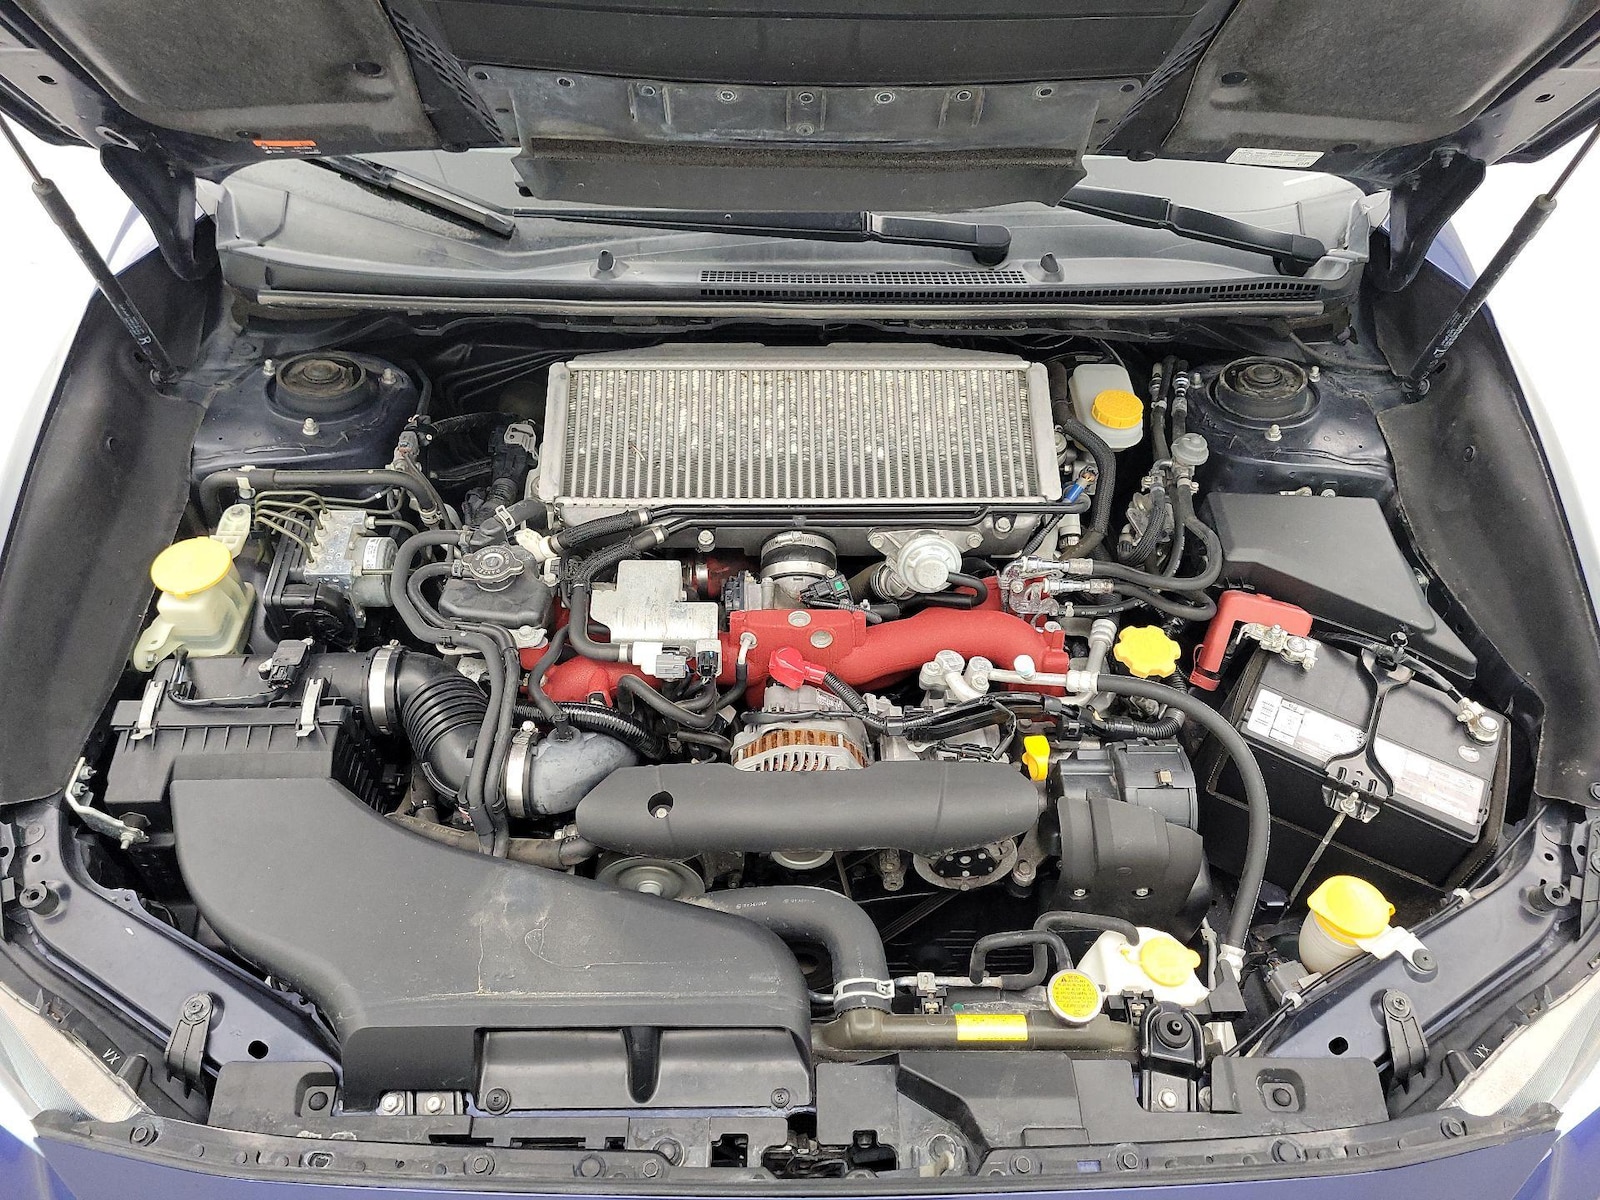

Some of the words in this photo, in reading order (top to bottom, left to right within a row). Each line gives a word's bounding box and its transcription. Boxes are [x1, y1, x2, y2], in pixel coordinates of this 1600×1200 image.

[138, 335, 152, 345] R
[102, 1048, 121, 1065] VX
[1473, 1043, 1492, 1058] VX
